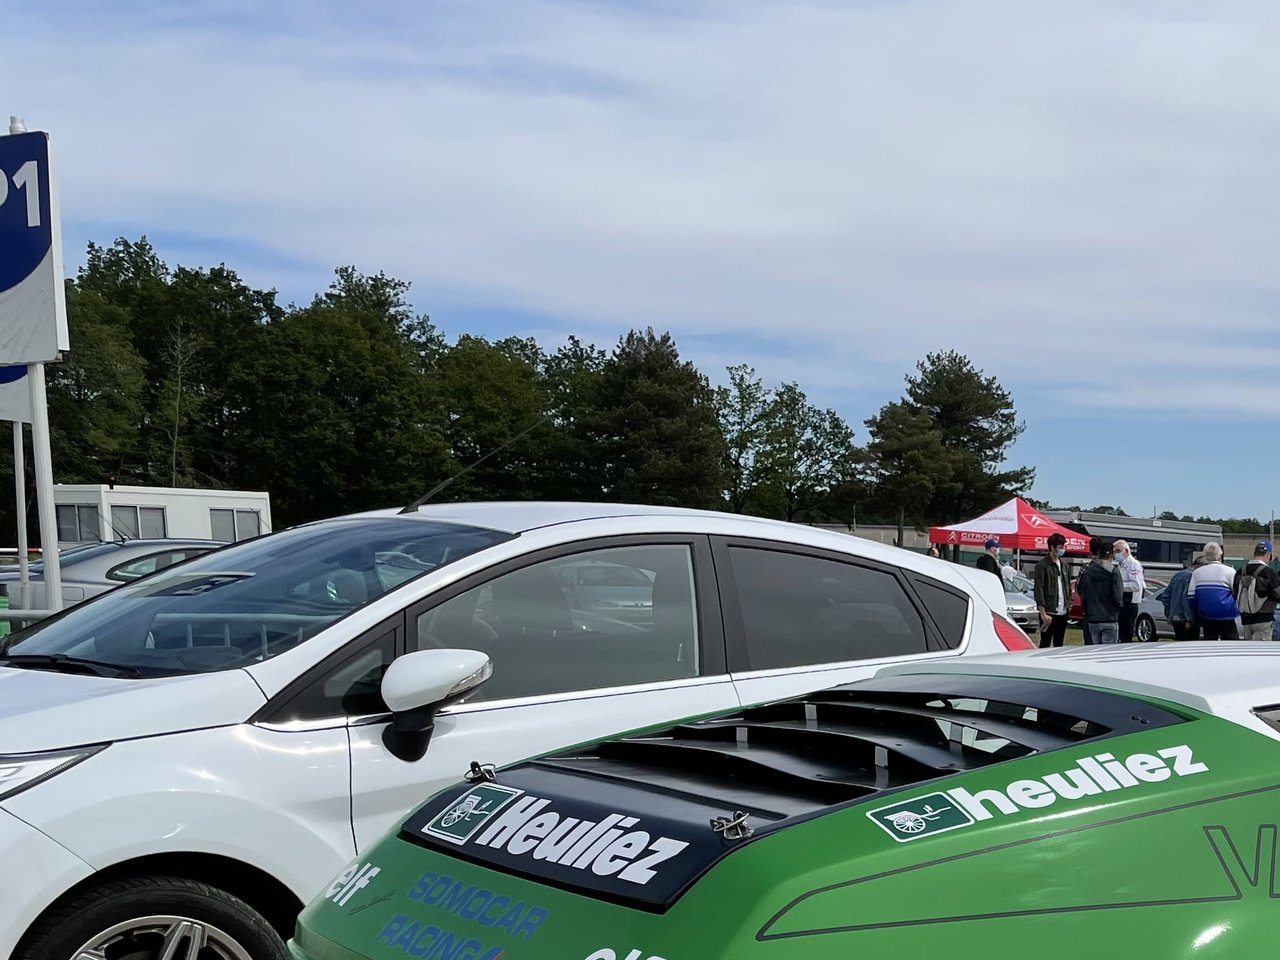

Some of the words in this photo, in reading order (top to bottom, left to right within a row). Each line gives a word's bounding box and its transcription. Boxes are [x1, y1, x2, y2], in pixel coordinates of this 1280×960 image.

[950, 744, 1209, 822] heuliez
[474, 795, 690, 885] Heuliez
[324, 862, 382, 907] elf
[407, 870, 550, 941] SOMOCAR
